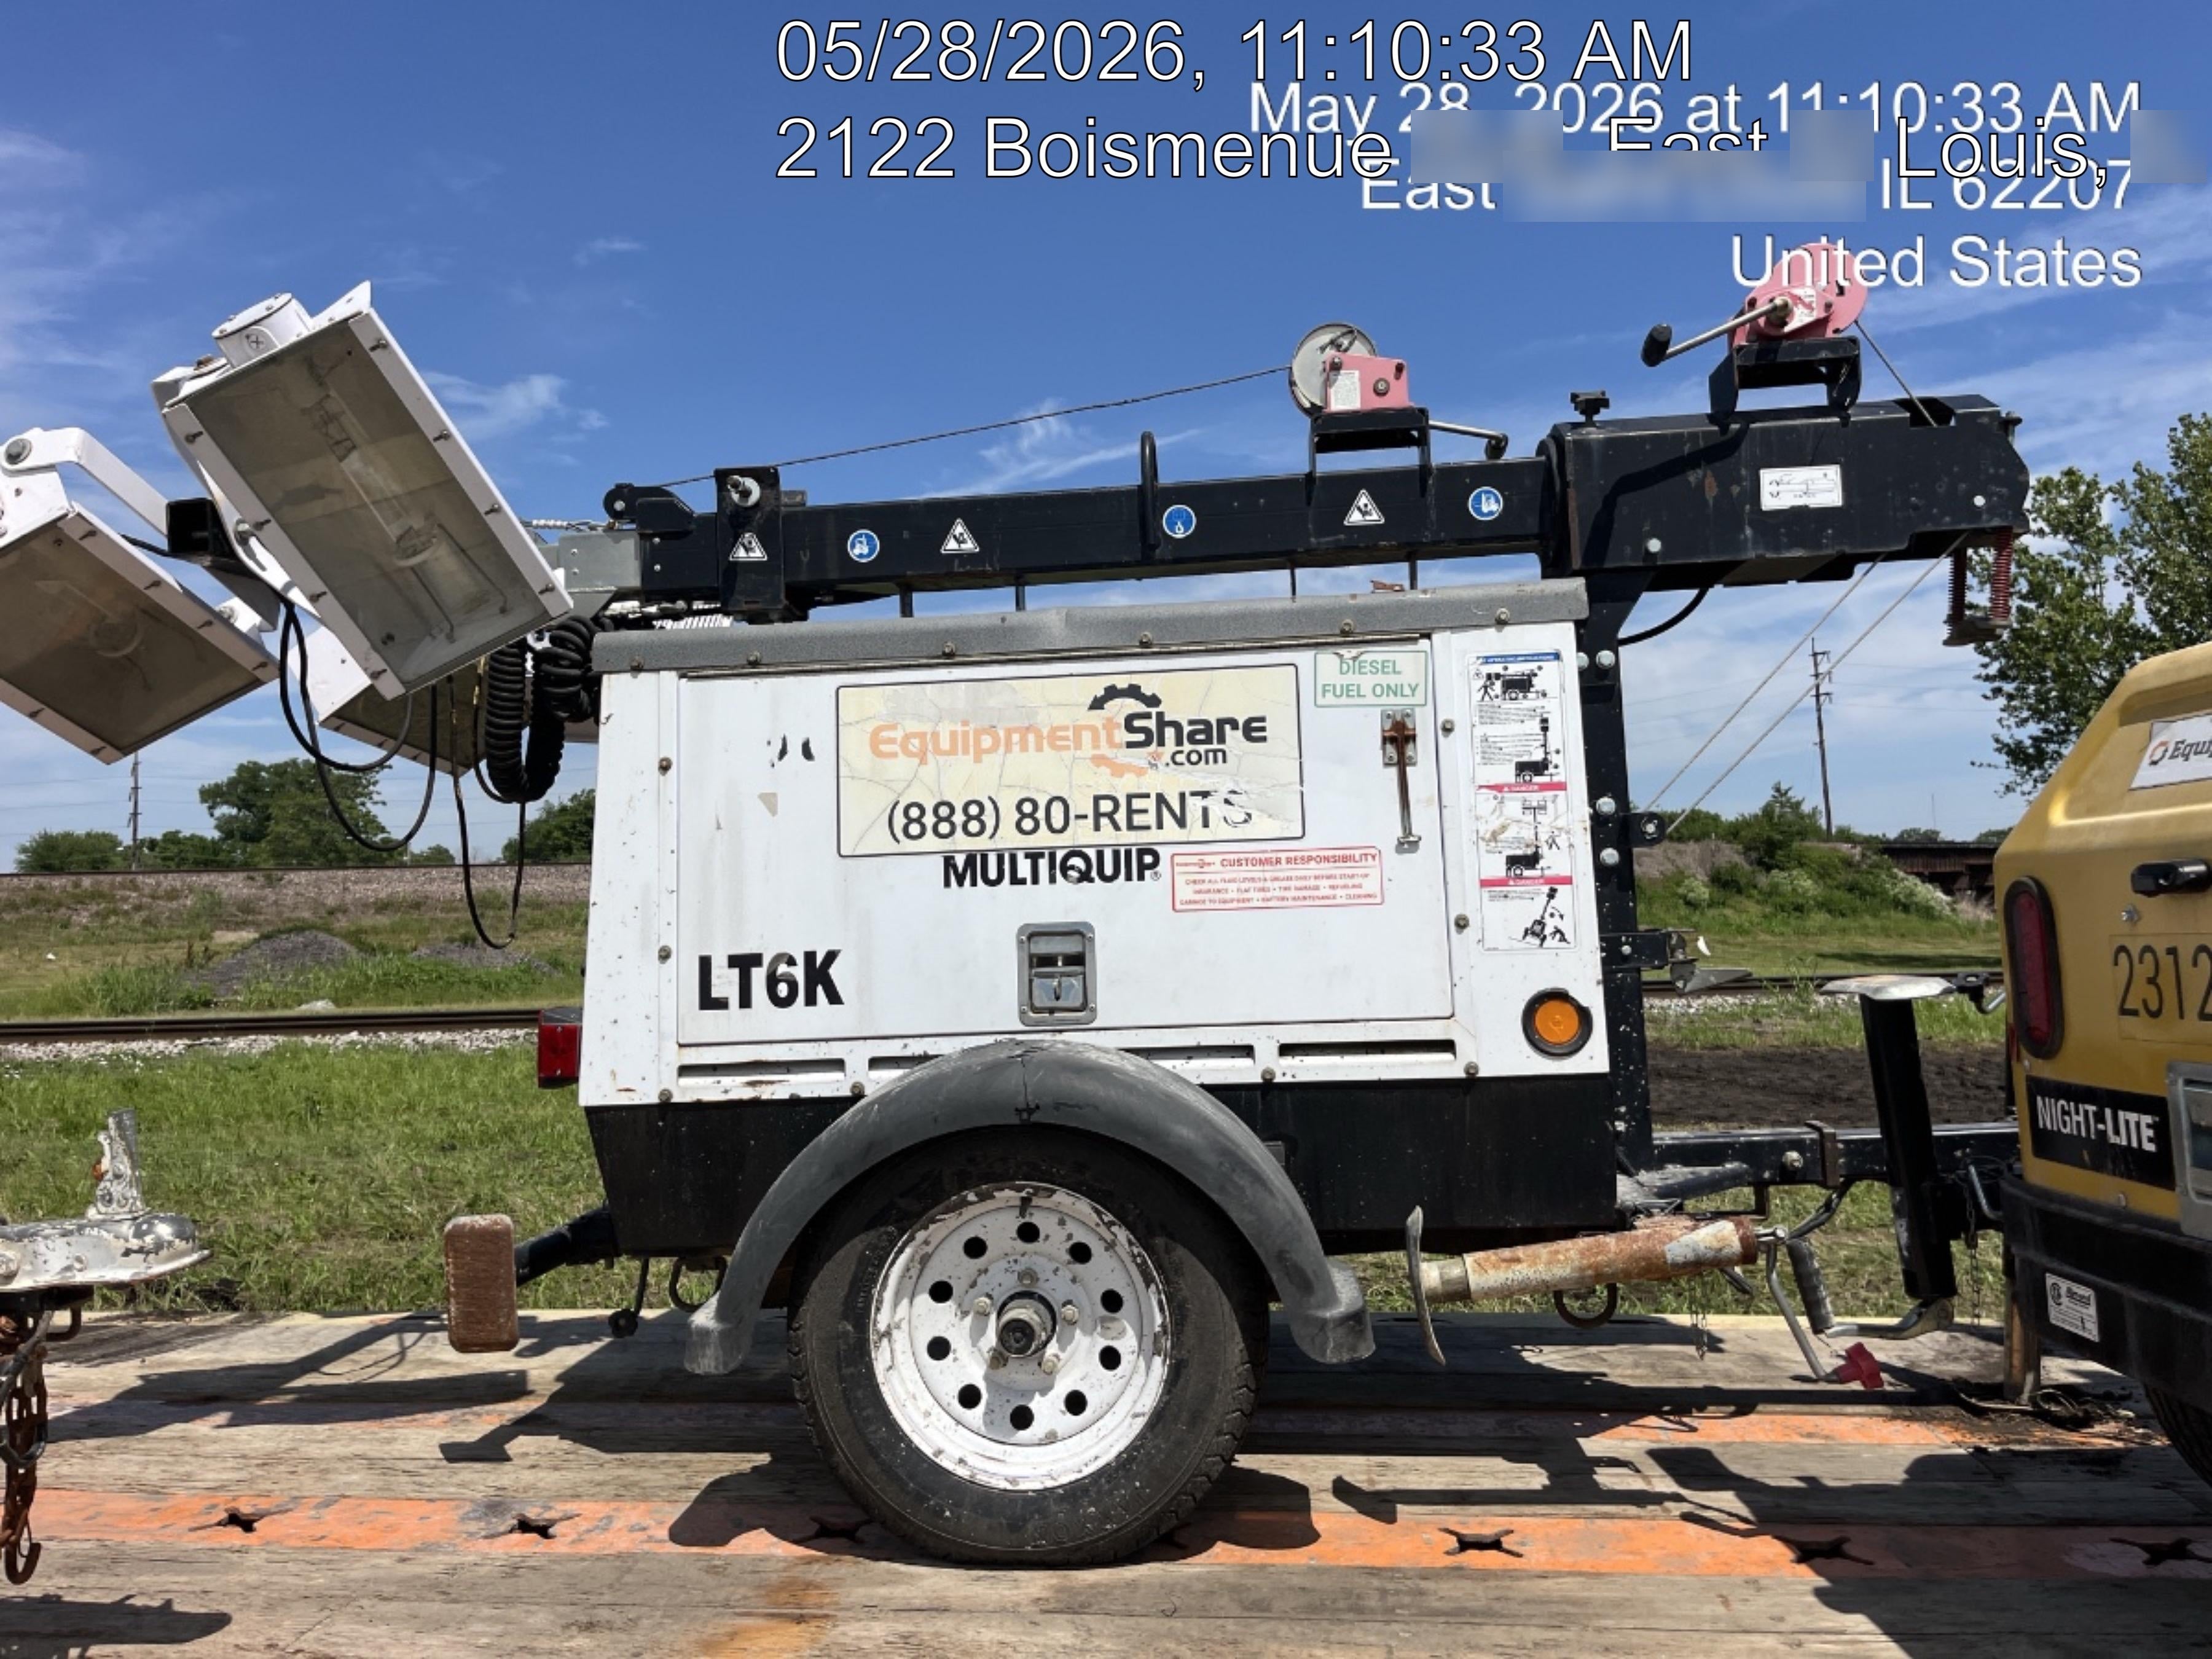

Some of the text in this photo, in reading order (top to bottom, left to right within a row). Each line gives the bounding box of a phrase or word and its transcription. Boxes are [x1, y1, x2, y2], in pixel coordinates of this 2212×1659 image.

[1338, 659, 1402, 675] DIESEL
[1322, 682, 1419, 698] FUEL ONLY
[869, 711, 1268, 763] EquipmentShare
[2168, 738, 2212, 762] Equi
[1165, 748, 1227, 767] .com
[888, 789, 1252, 844] (888) 80-RENTS
[1220, 855, 1282, 868] CUSTOMER
[1286, 853, 1378, 866] RESPONSIBILITY
[698, 949, 845, 1011] LT6K
[2114, 944, 2212, 1021] 2312
[2036, 1094, 2157, 1153] NIGHT-LITE
